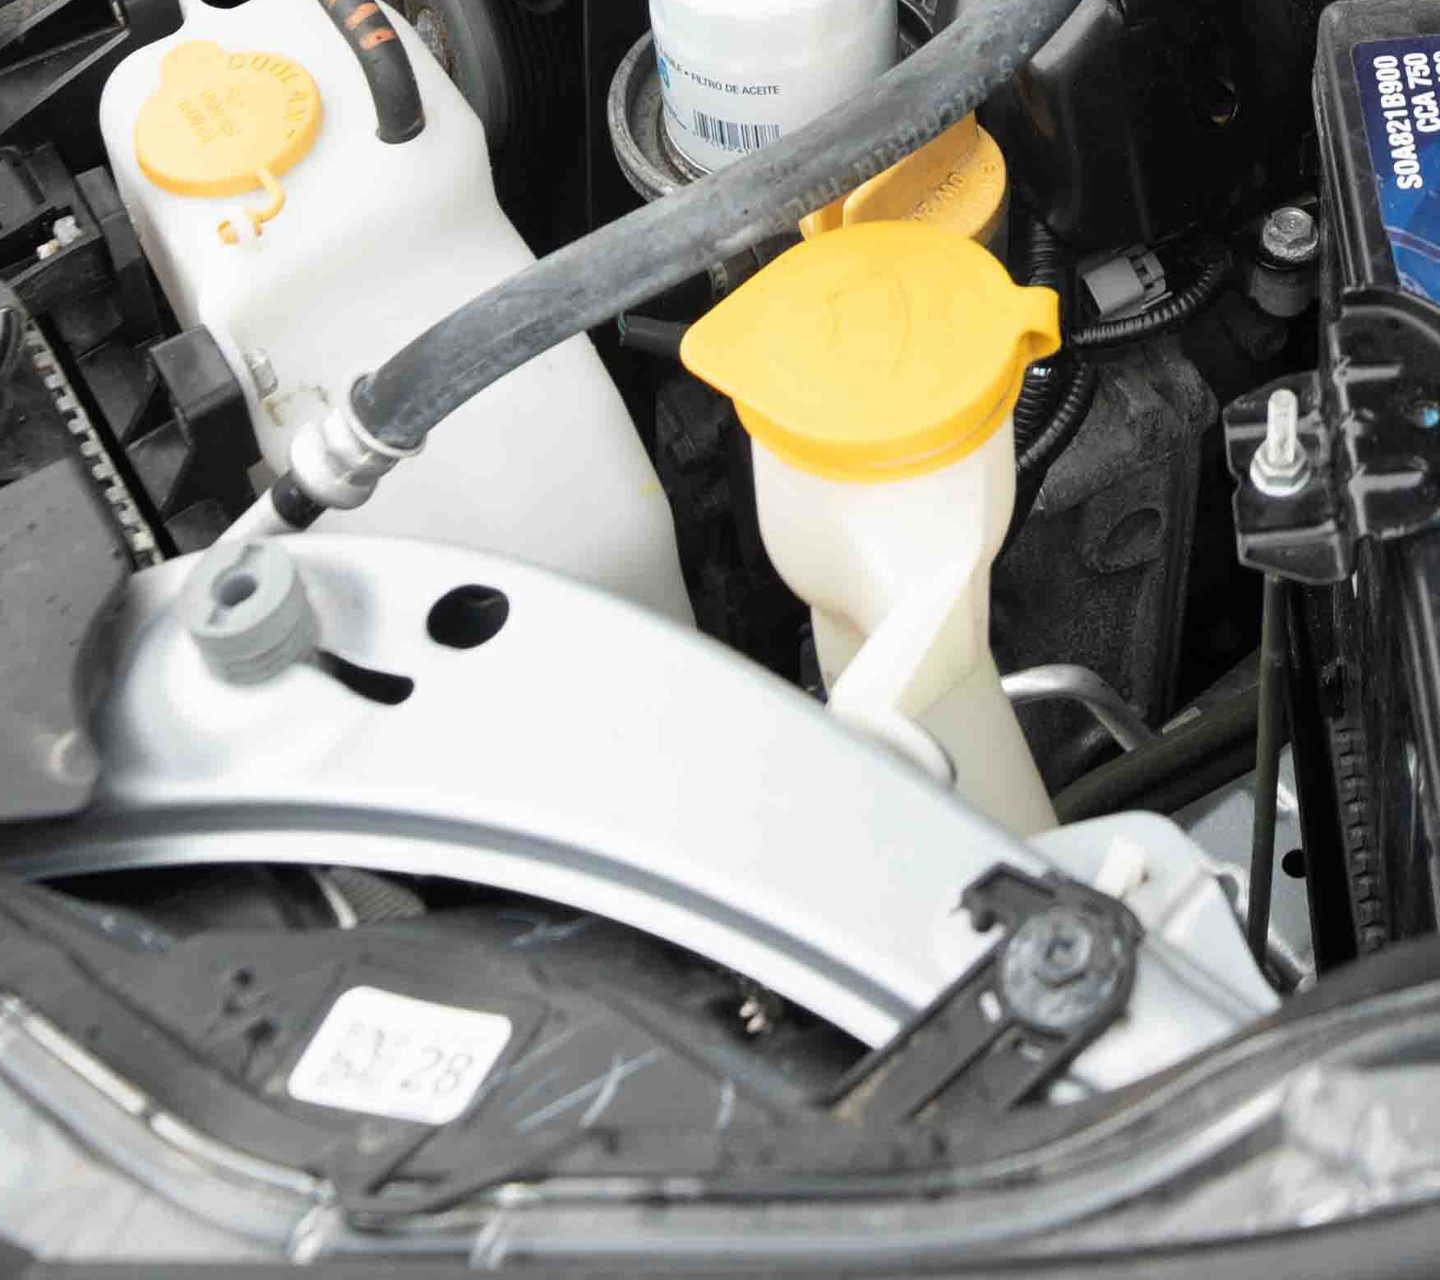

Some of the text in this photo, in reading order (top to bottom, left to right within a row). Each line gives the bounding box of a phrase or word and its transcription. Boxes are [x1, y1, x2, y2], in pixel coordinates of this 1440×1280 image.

[1403, 53, 1432, 86] 750
[691, 73, 782, 96] FILTRO DE ACEITE
